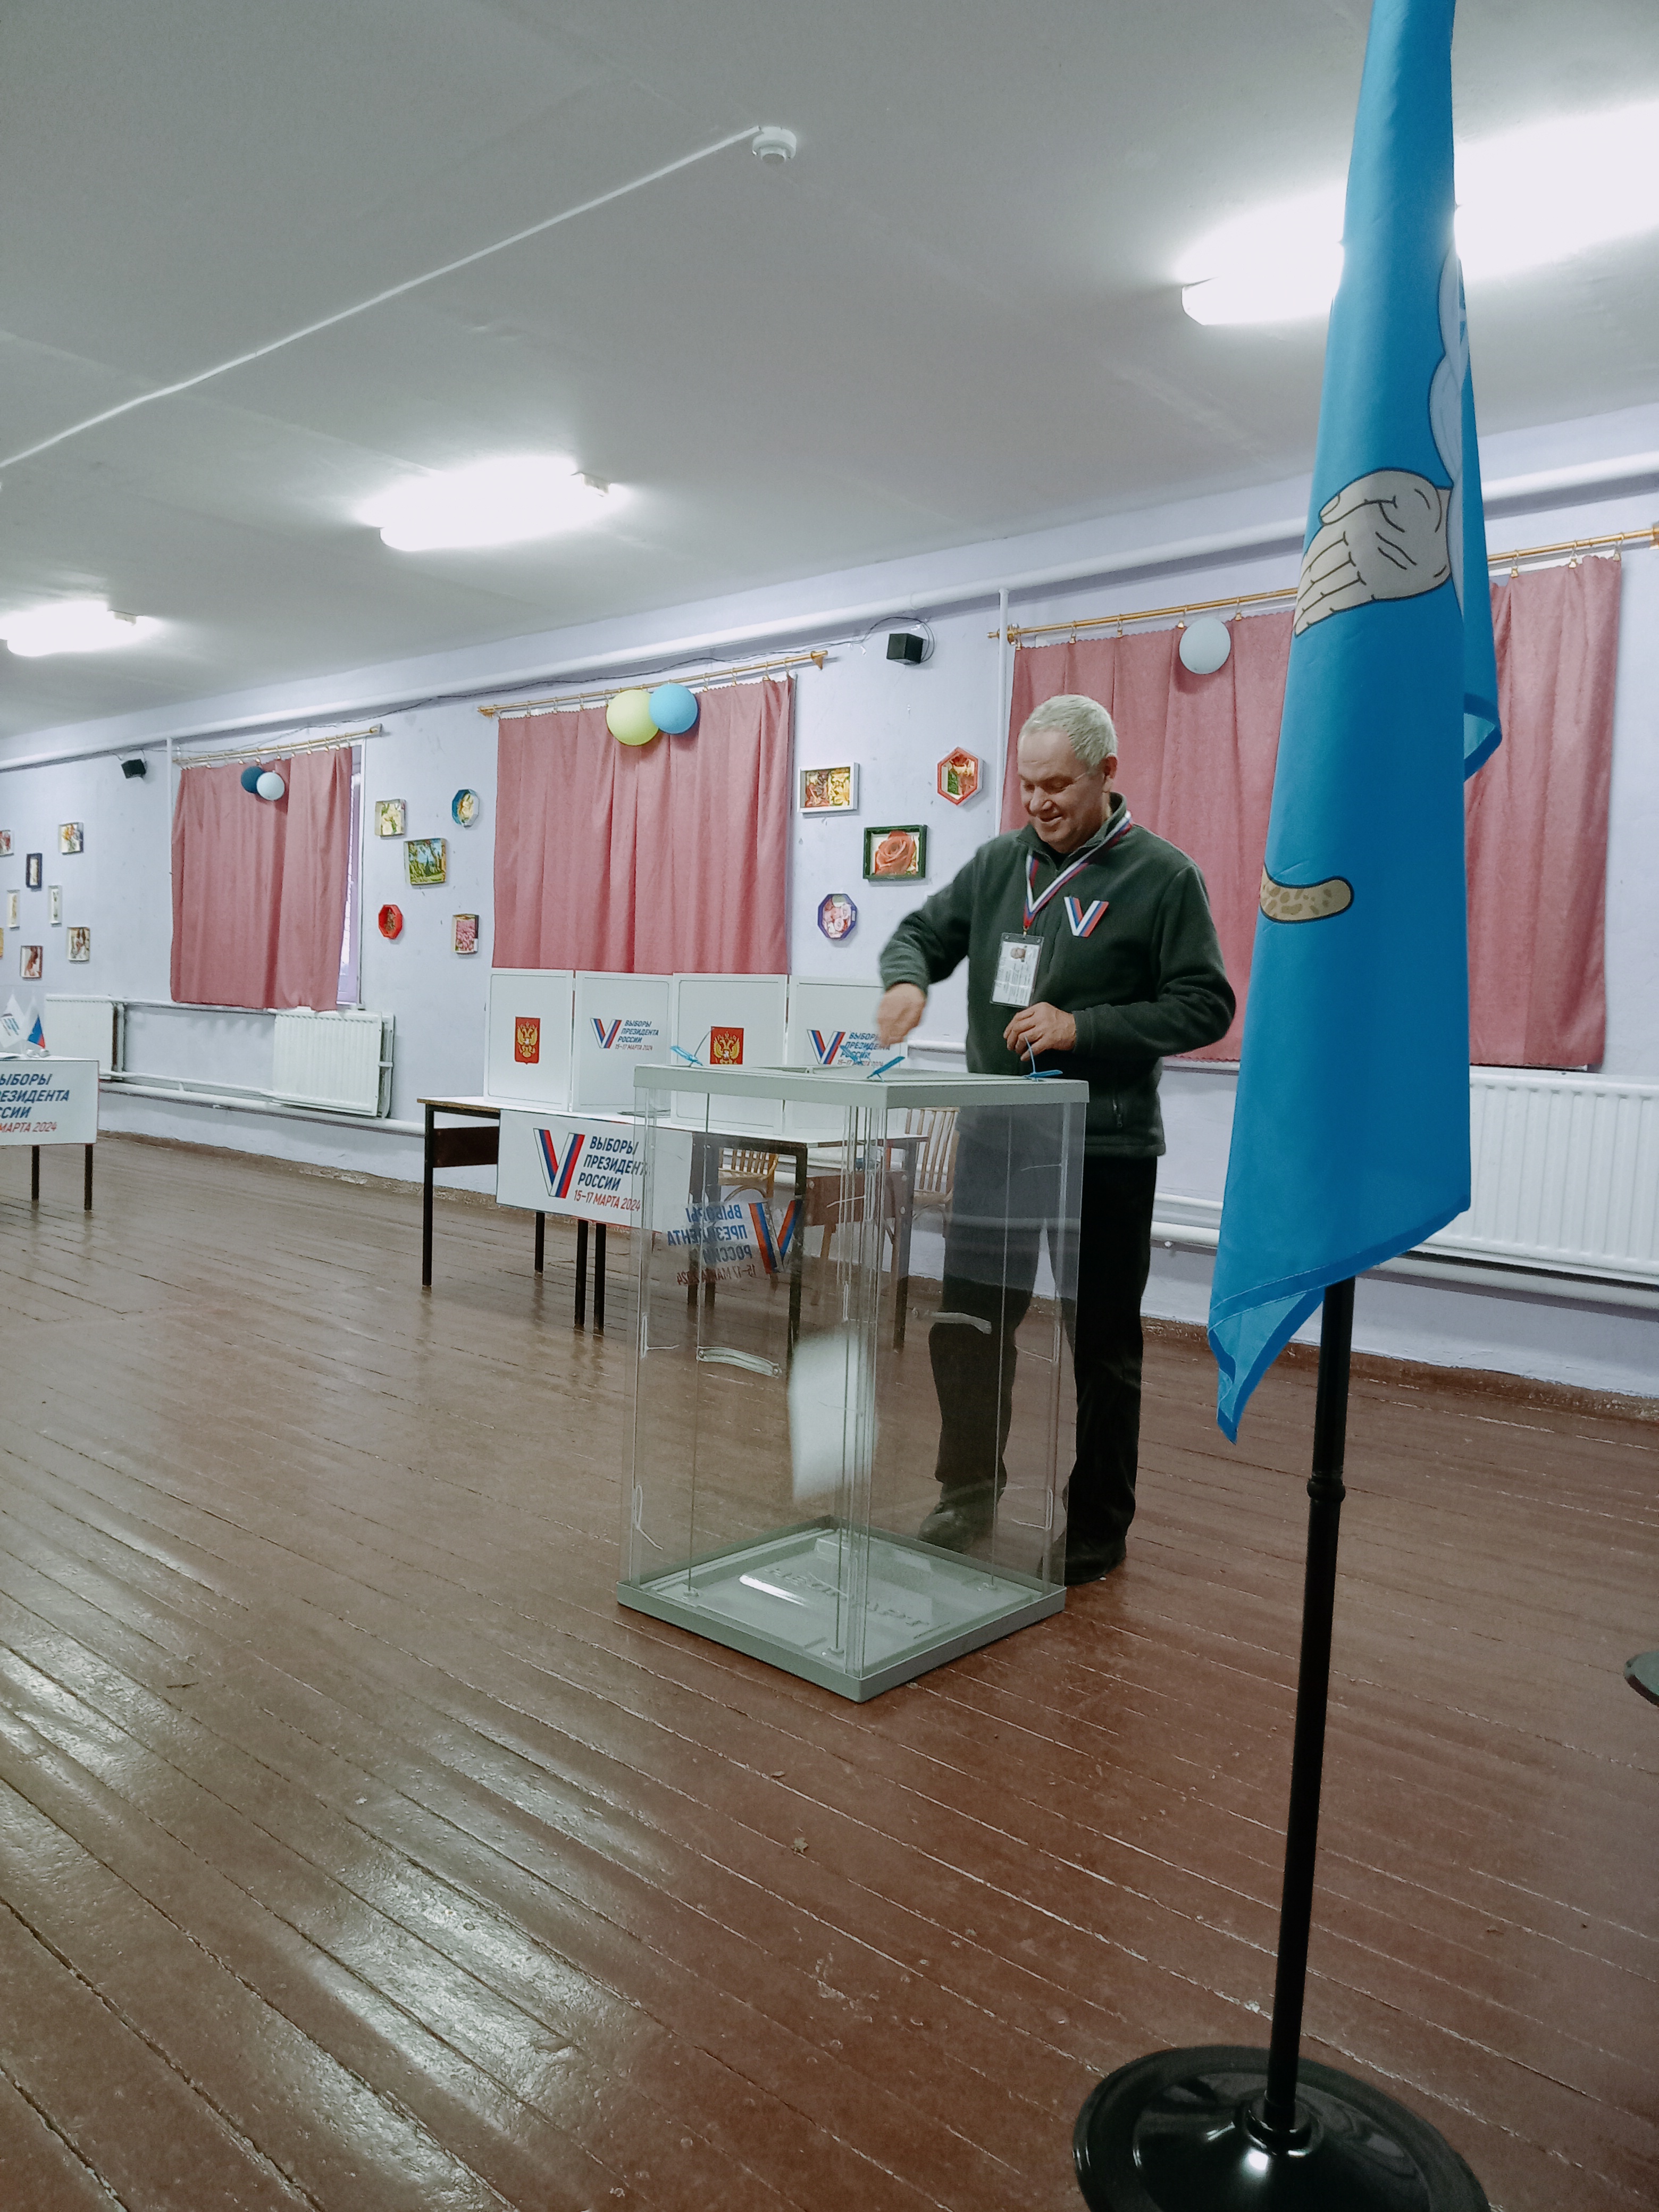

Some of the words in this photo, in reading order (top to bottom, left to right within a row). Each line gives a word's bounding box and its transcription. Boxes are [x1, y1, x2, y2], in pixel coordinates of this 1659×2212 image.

[621, 1028, 659, 1036] ПРЕЗИДЕНТА
[845, 1041, 890, 1051] ПРЕЗИДЕА
[0, 1074, 53, 1086] ЫБОРЫ
[0, 1090, 70, 1103] ЕЗИДЕНТА
[32, 1121, 57, 1132] 2024
[589, 1136, 639, 1155] ВЫБОРЫ
[583, 1154, 647, 1176] ПРЕЗИДЕНТ
[577, 1172, 621, 1191] РОССИИ
[593, 1193, 619, 1209] МАРТА
[620, 1197, 641, 1212] 2024
